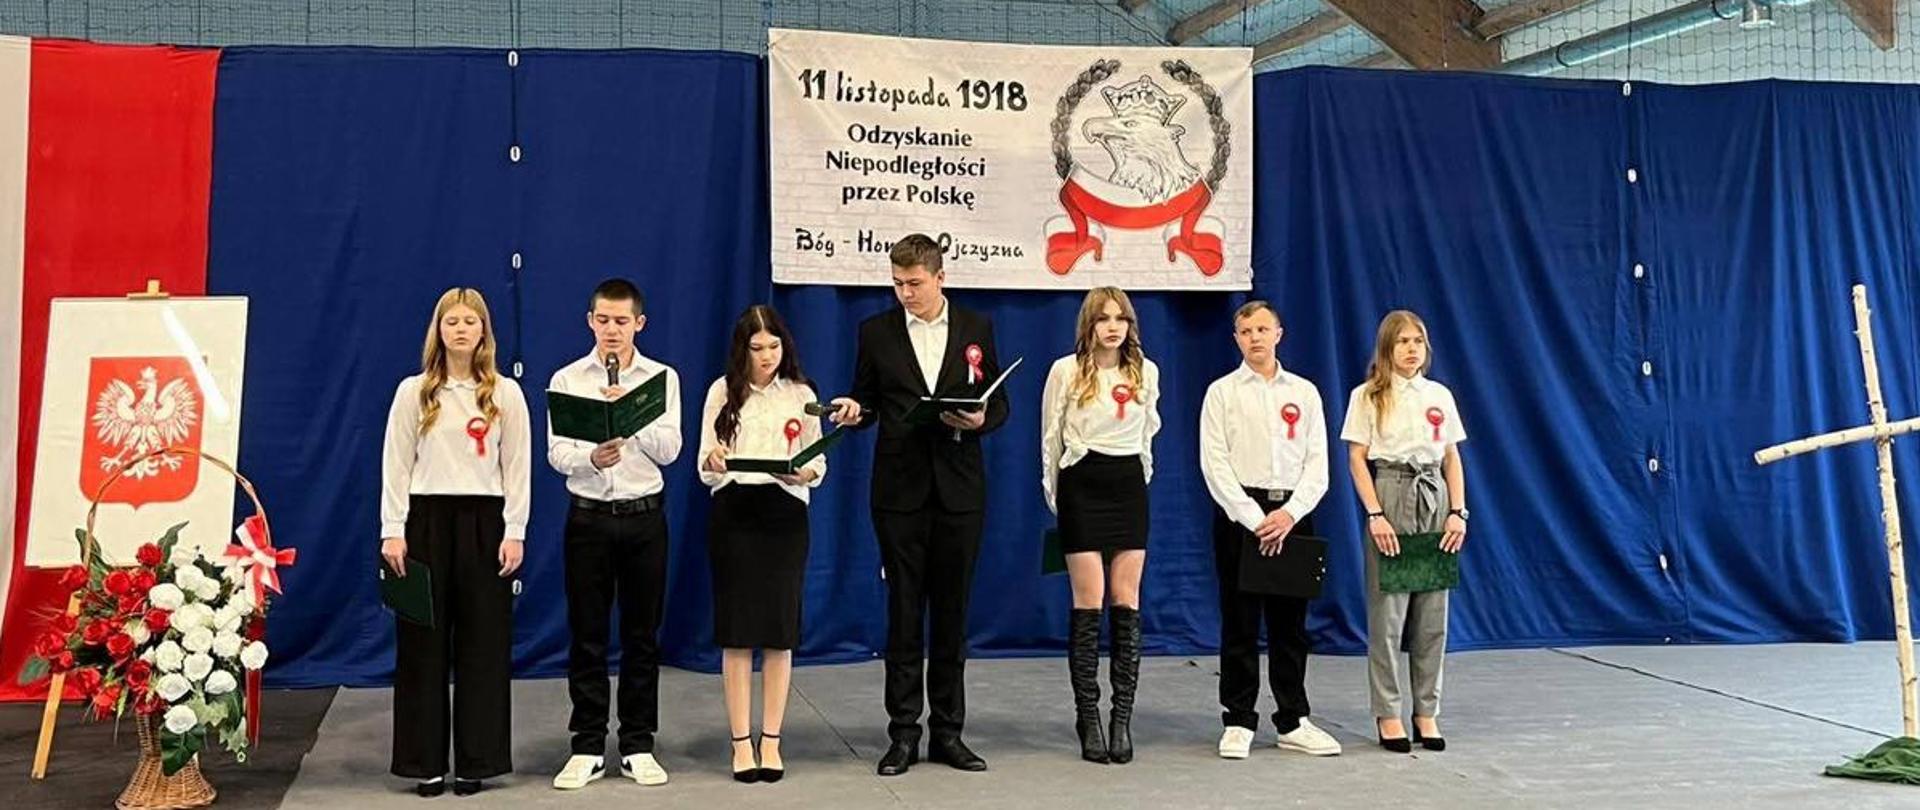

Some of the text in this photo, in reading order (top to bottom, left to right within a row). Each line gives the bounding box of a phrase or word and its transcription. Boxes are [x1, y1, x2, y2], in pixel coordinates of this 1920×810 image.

[798, 68, 1028, 111] 11 listopada 1918
[847, 123, 973, 150] Odzyskanie
[825, 150, 986, 181] Niepodległości
[842, 184, 975, 211] przez Polskę
[795, 228, 835, 257] Bóg
[857, 229, 896, 253] Hon
[936, 232, 1024, 261] Ojczyzna
